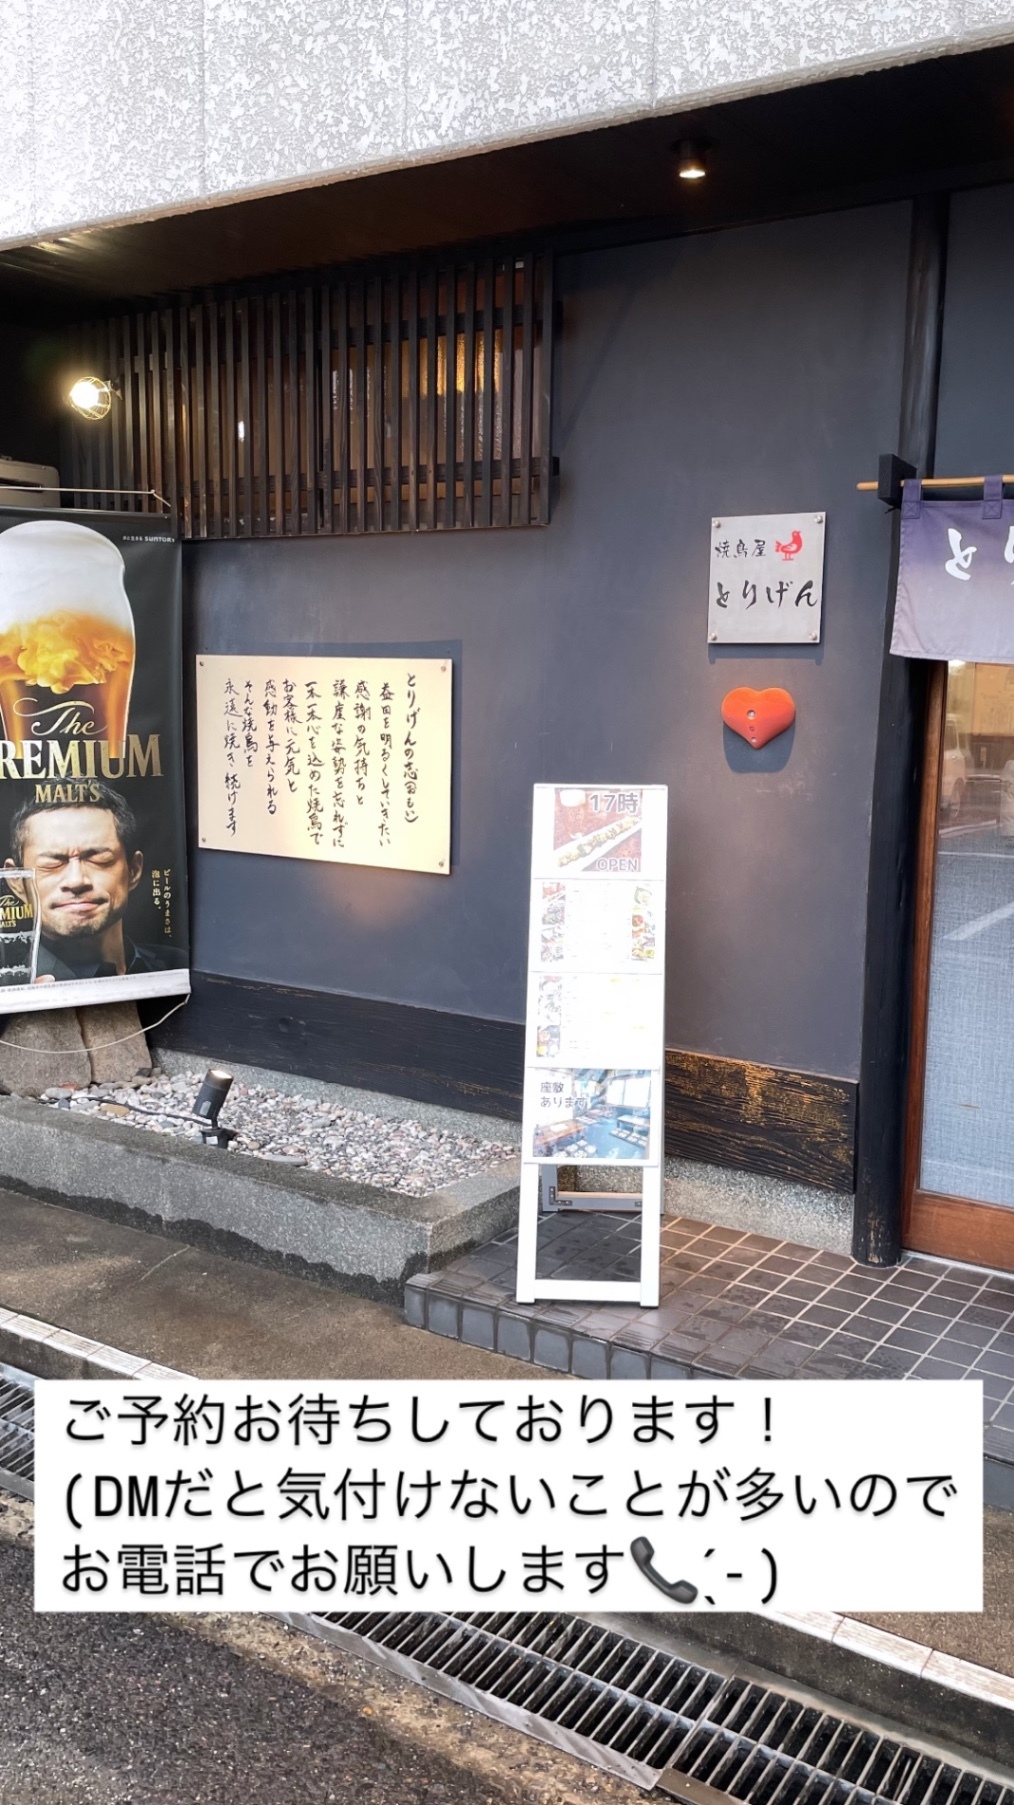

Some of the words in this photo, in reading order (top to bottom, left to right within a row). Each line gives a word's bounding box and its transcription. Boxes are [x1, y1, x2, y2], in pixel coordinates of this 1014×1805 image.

[714, 539, 767, 558] 焼鳥屋
[716, 580, 818, 609] とりげん
[13, 697, 108, 736] The
[242, 681, 259, 768] そんな焼鳥を
[282, 678, 303, 793] お客様に元気と
[223, 678, 243, 836] 永遠に焼き続けます
[263, 678, 280, 815] 感動を与えられる
[353, 680, 371, 805] 感謝の気持ちと
[304, 681, 325, 845] 一本一本心を込めた焼鳥で
[331, 679, 350, 847] 謙虚な姿勢を忘れずに
[35, 780, 101, 803] MALT'S
[590, 792, 639, 814] 17時
[597, 858, 638, 871] OPEN
[151, 869, 162, 910] 泡に出る。
[540, 1081, 564, 1094] 座敷
[540, 1096, 588, 1109] あります
